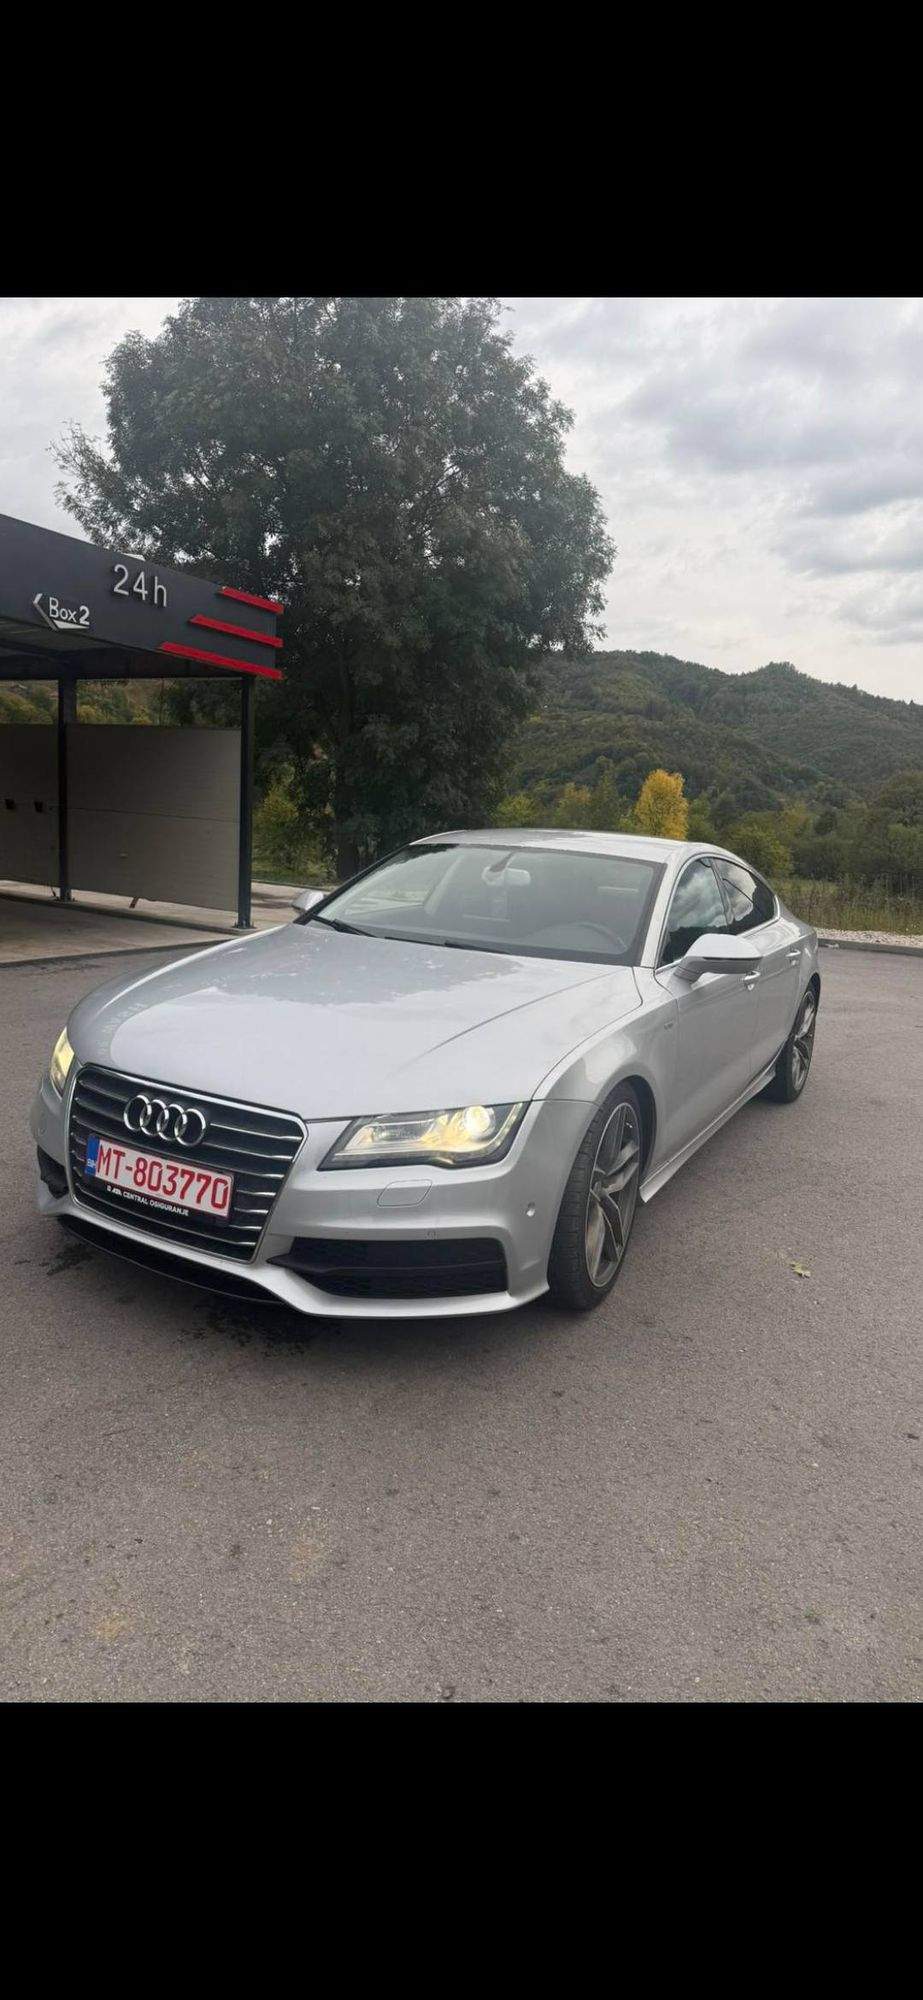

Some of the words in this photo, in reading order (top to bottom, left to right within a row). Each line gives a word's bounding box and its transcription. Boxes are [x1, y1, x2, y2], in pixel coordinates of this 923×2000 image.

[113, 564, 168, 608] 24h
[97, 1143, 229, 1210] MT-803770
[123, 1191, 148, 1205] CENTRAL
